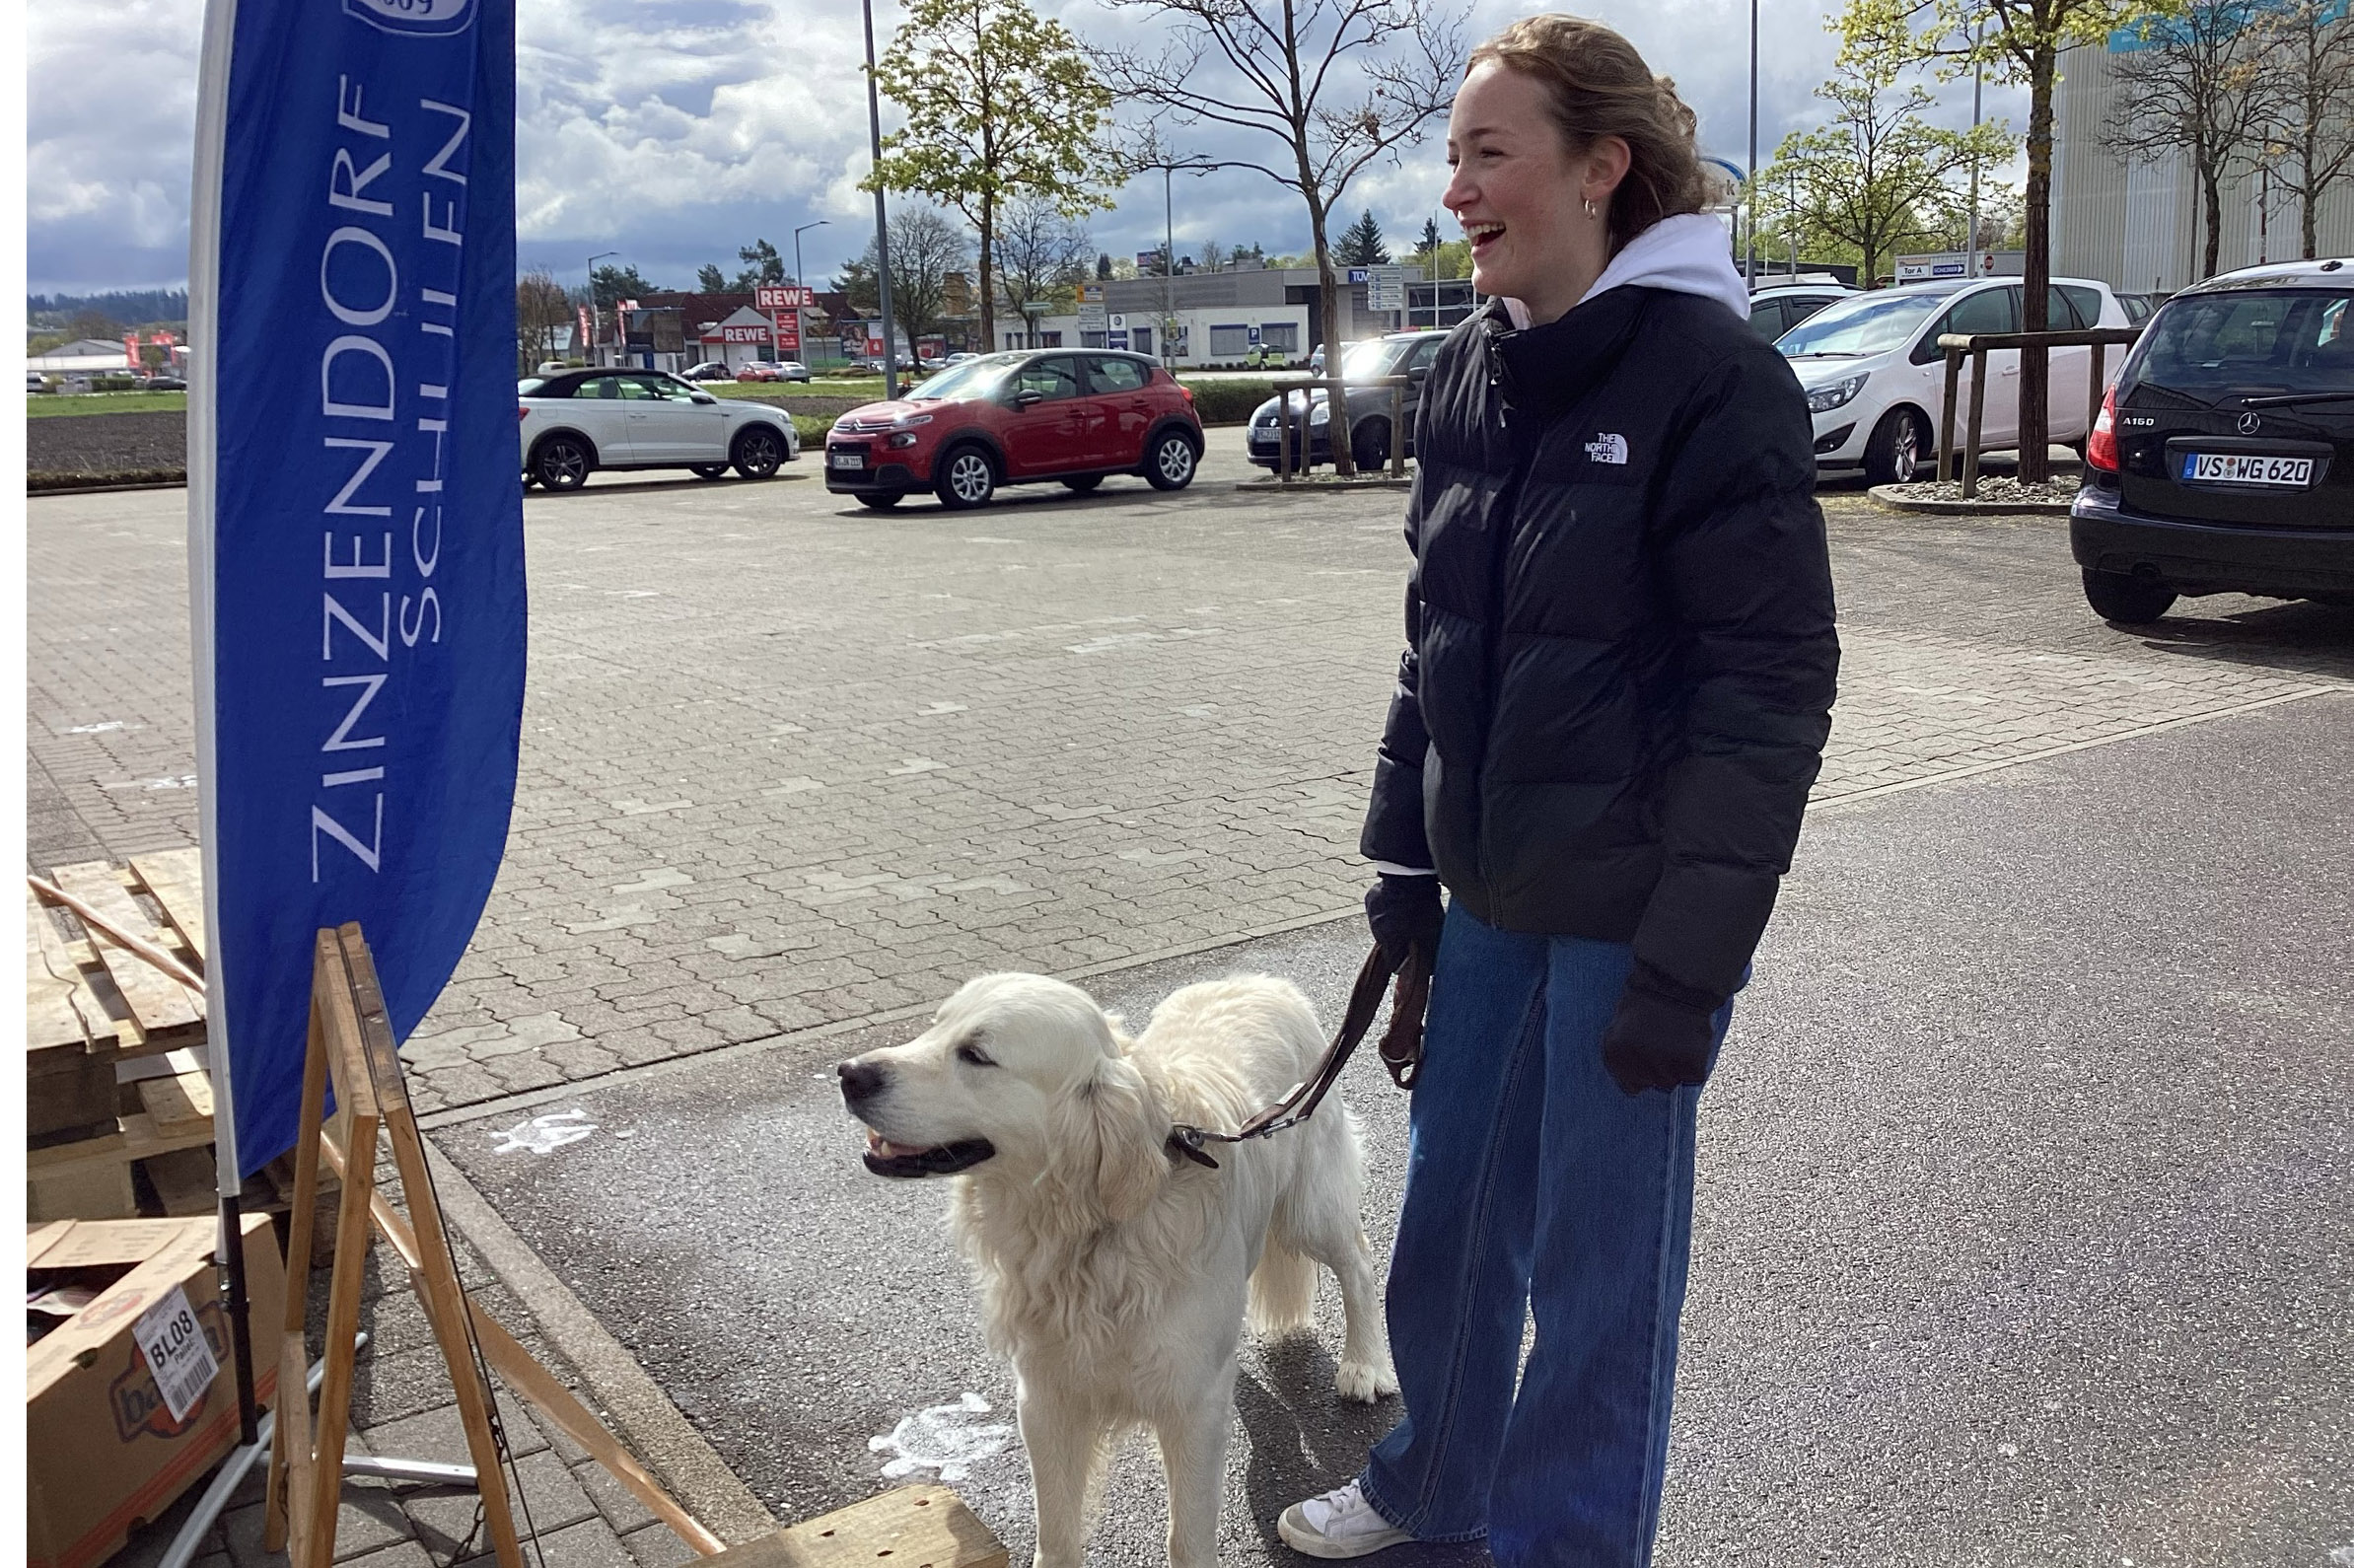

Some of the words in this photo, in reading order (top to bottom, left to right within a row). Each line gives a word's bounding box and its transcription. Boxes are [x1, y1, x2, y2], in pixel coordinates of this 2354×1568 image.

[759, 289, 812, 306] REWE
[724, 327, 767, 342] REWE
[1598, 432, 1616, 443] THE
[1584, 442, 1613, 454] NORTH
[1591, 453, 1613, 463] FACE
[2197, 456, 2224, 478] VS
[2235, 459, 2264, 480] WG
[2267, 461, 2310, 483] 620
[312, 74, 397, 884] ZINZENDORF
[149, 1309, 194, 1371] BL08
